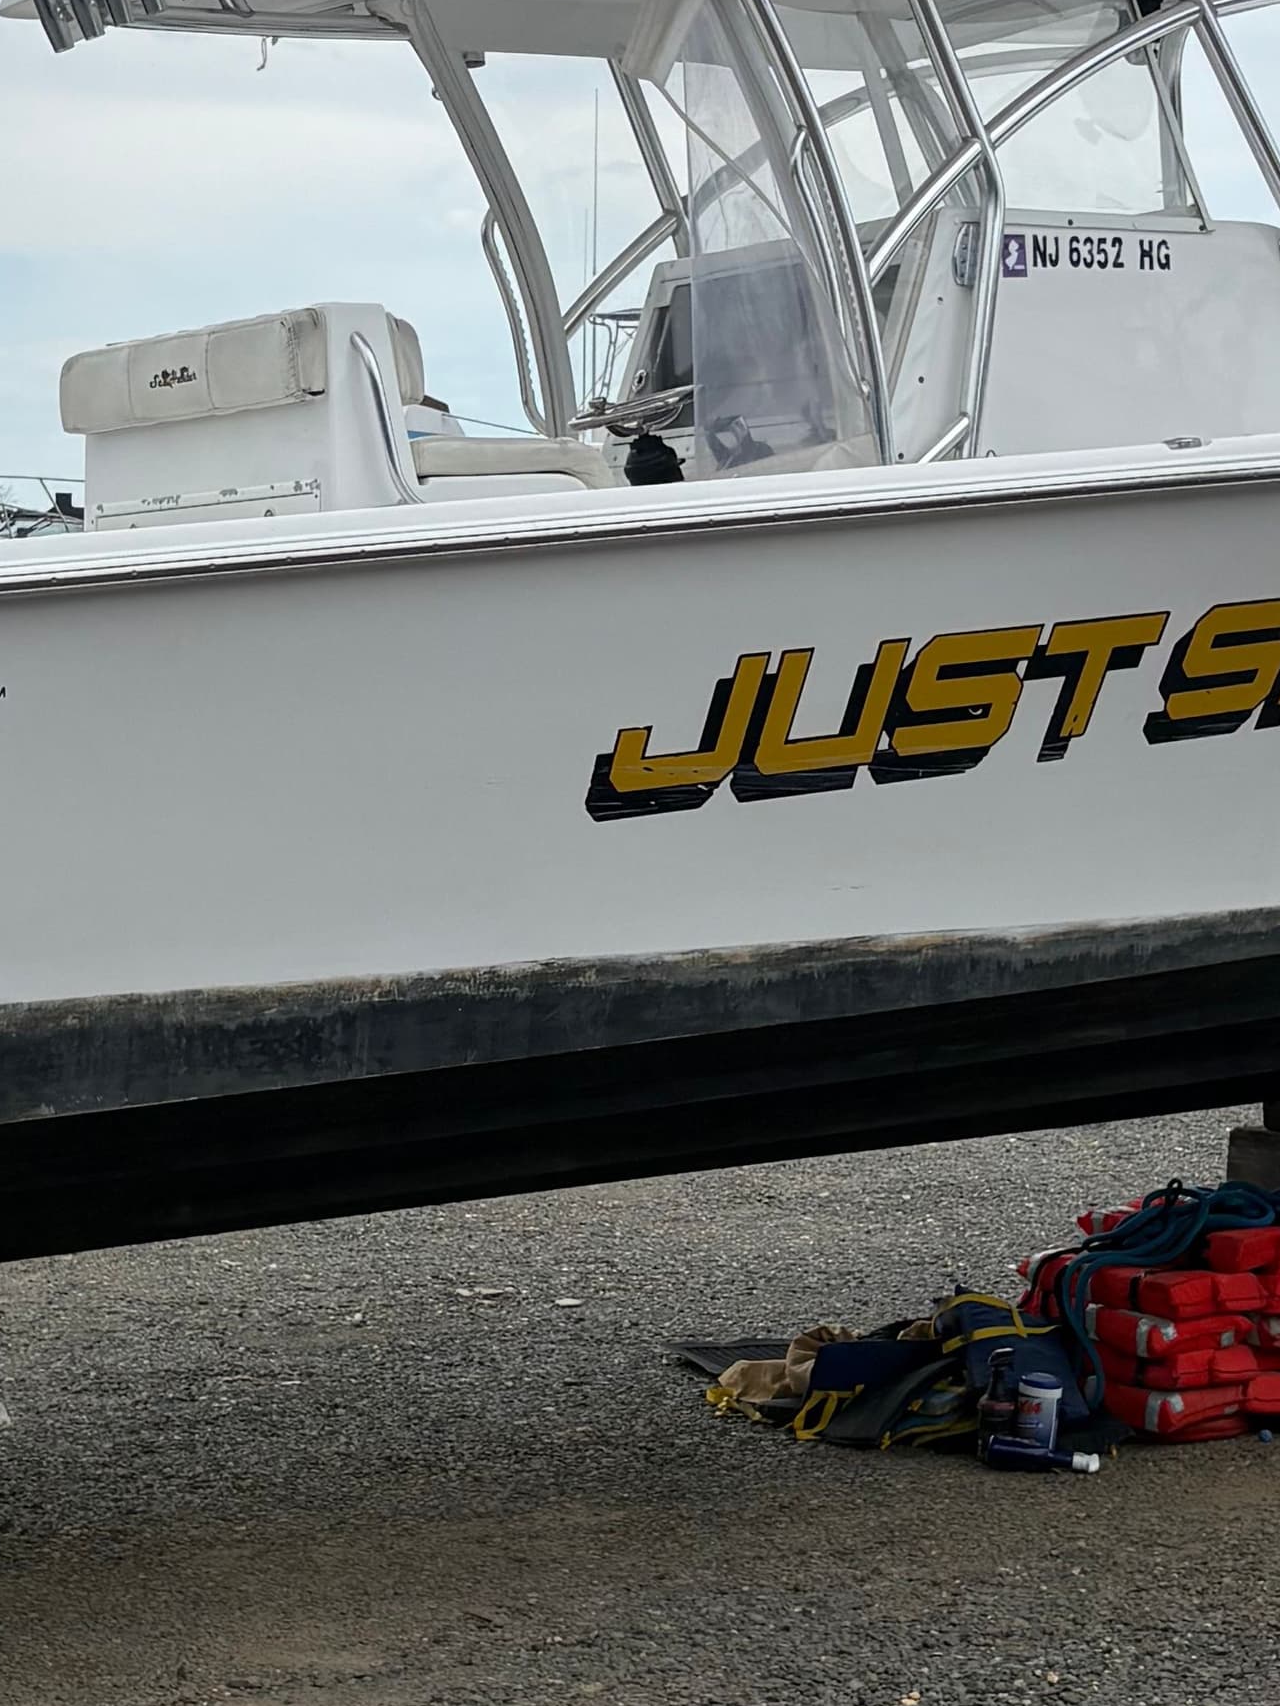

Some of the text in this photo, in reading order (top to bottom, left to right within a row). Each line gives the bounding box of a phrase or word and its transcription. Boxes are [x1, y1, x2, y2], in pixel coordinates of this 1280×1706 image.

[1032, 234, 1171, 271] NJ 6352 HG
[585, 610, 1172, 823] JUST
